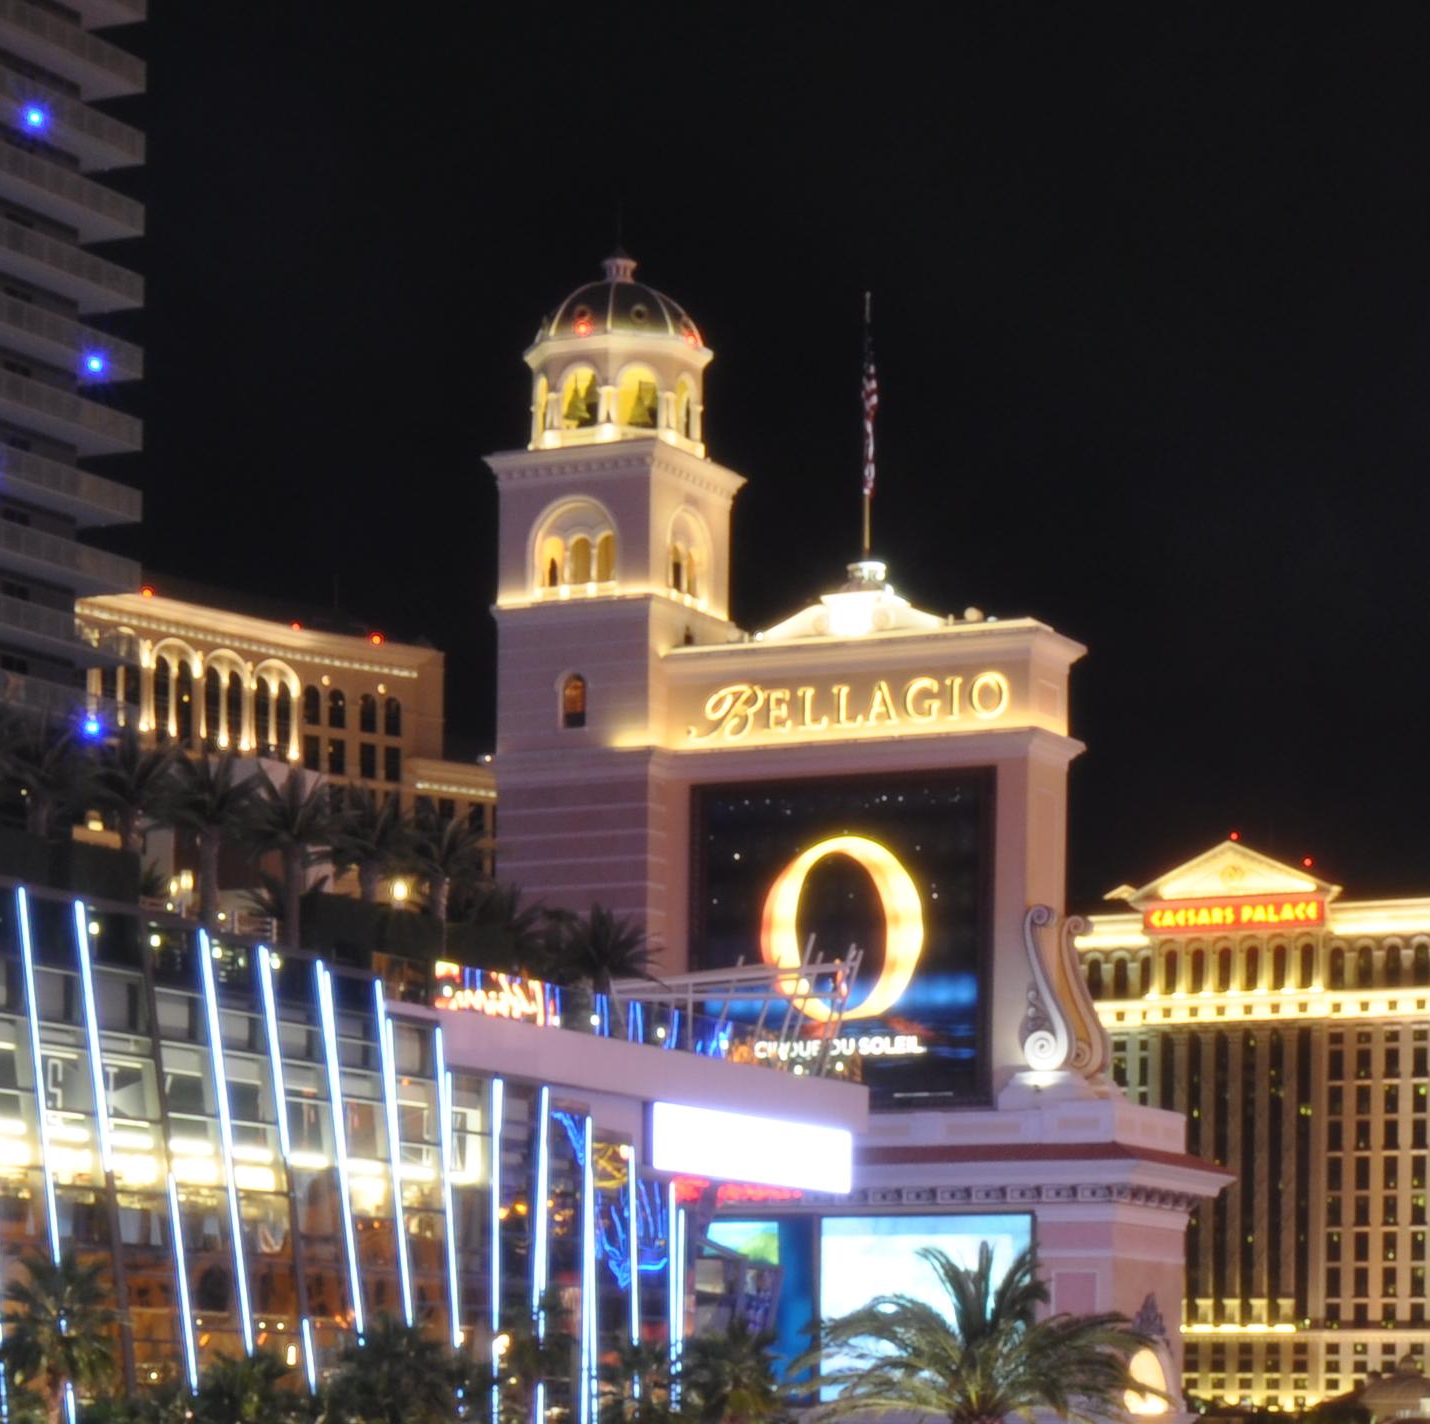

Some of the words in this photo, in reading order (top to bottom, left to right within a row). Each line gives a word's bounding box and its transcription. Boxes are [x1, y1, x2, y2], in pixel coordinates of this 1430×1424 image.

[687, 671, 1008, 741] BELLAGIO
[1150, 906, 1235, 928] CAESARS
[1240, 901, 1318, 924] PALACE
